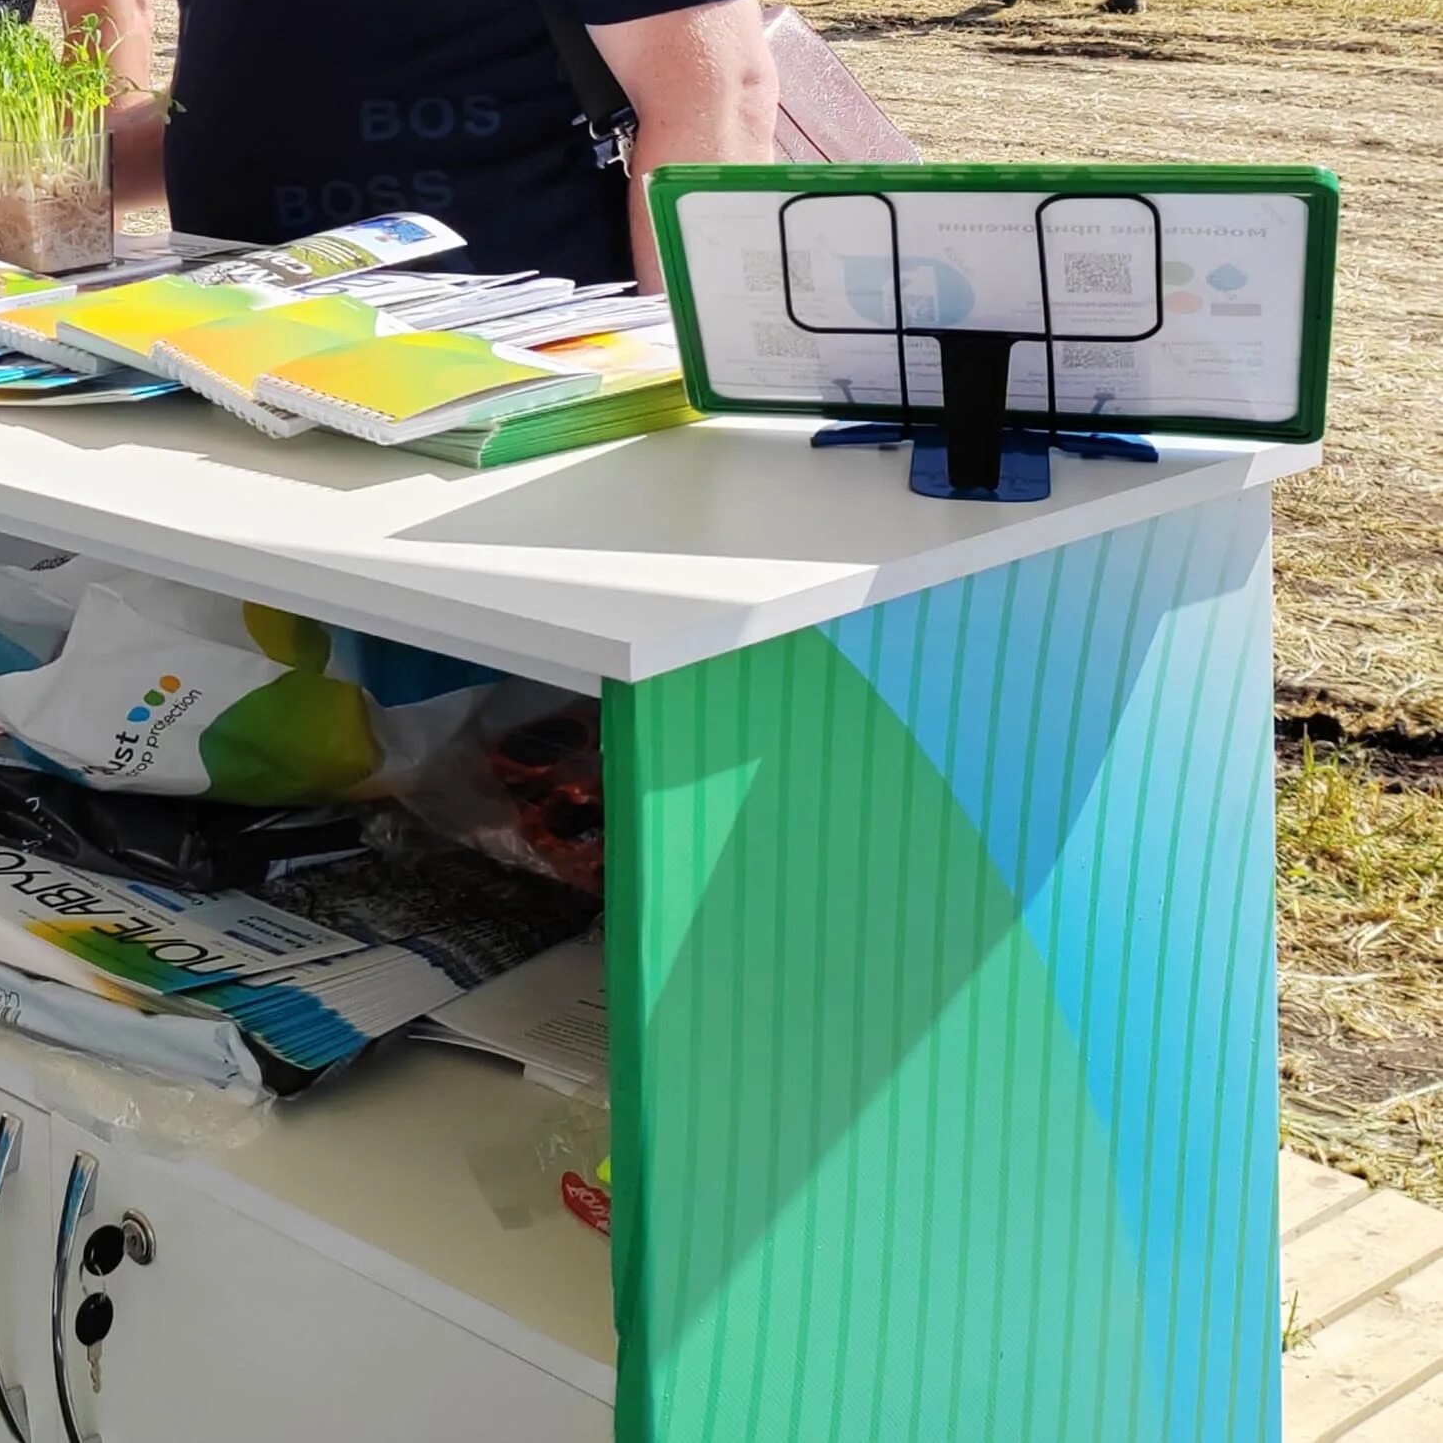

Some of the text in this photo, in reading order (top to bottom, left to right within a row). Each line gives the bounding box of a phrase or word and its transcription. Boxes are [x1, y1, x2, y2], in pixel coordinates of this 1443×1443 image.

[273, 169, 454, 227] BOSS
[147, 689, 203, 749] protection
[92, 915, 247, 976] ПОЛЕ
